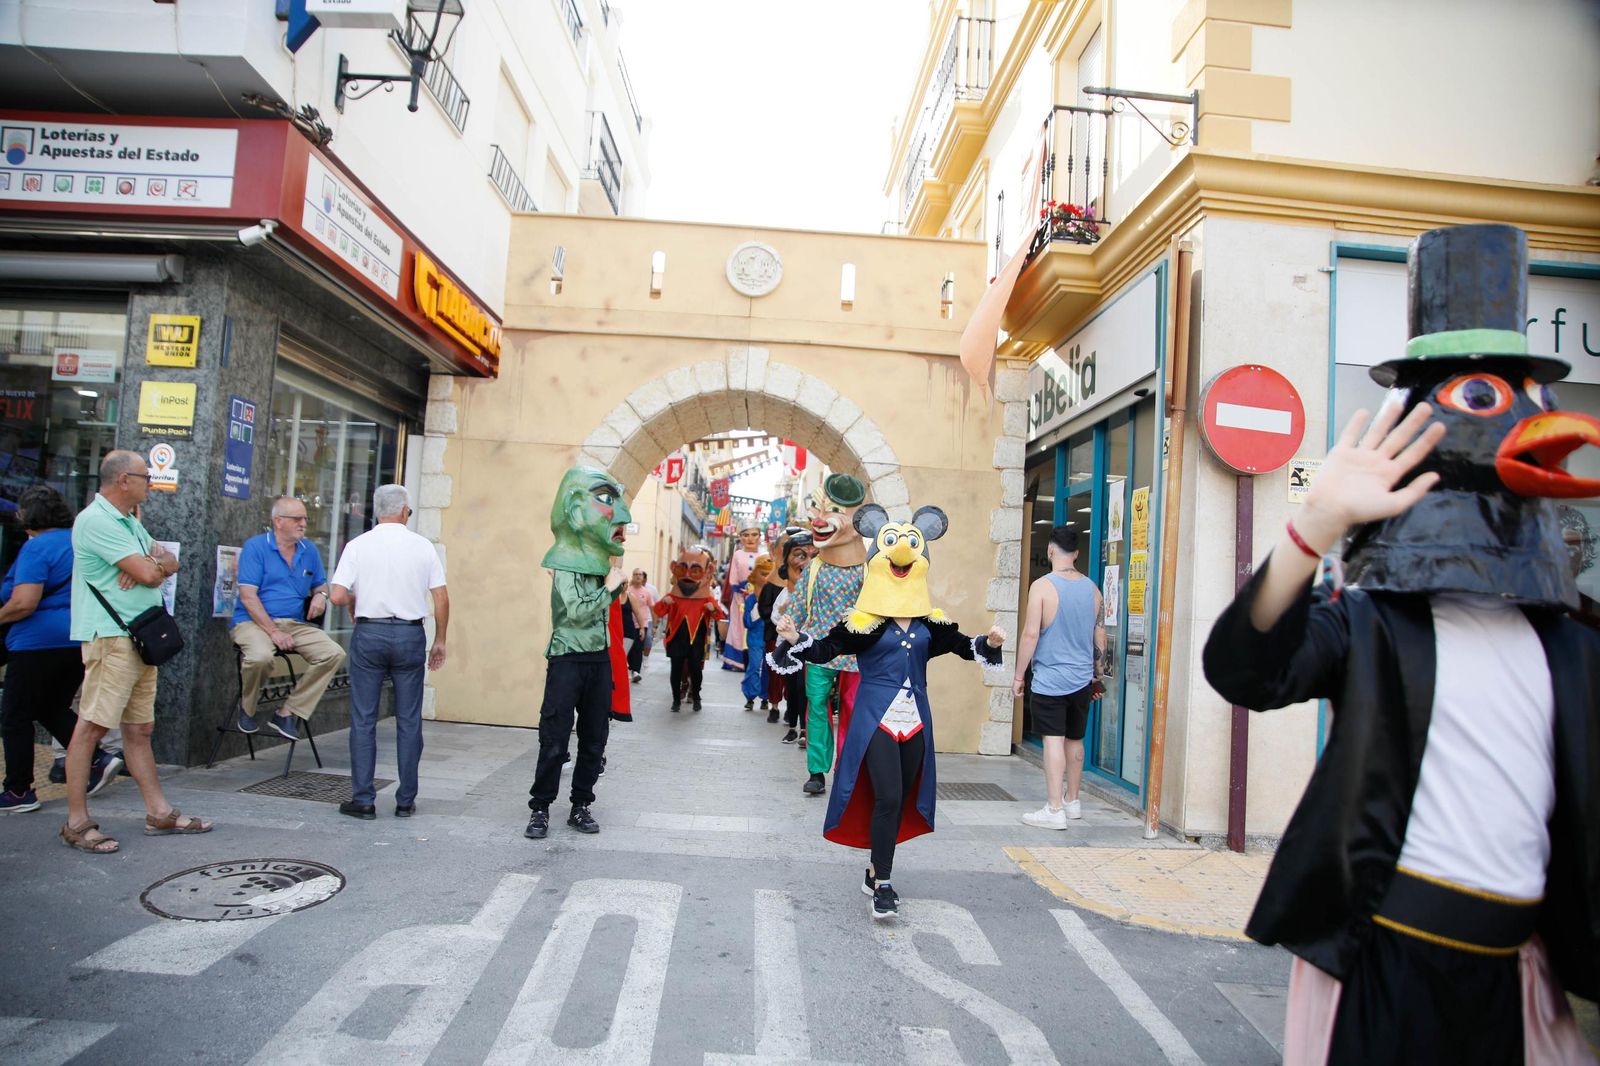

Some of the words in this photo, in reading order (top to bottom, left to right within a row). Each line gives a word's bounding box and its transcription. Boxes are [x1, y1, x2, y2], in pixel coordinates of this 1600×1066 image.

[40, 127, 105, 142] Loterías
[109, 133, 119, 146] y
[40, 144, 113, 160] Apuestas
[117, 147, 142, 160] del
[146, 148, 200, 162] Estado
[153, 344, 191, 352] WESTERN
[160, 395, 189, 405] inPost
[142, 426, 167, 435] Punto
[168, 428, 188, 436] Pack
